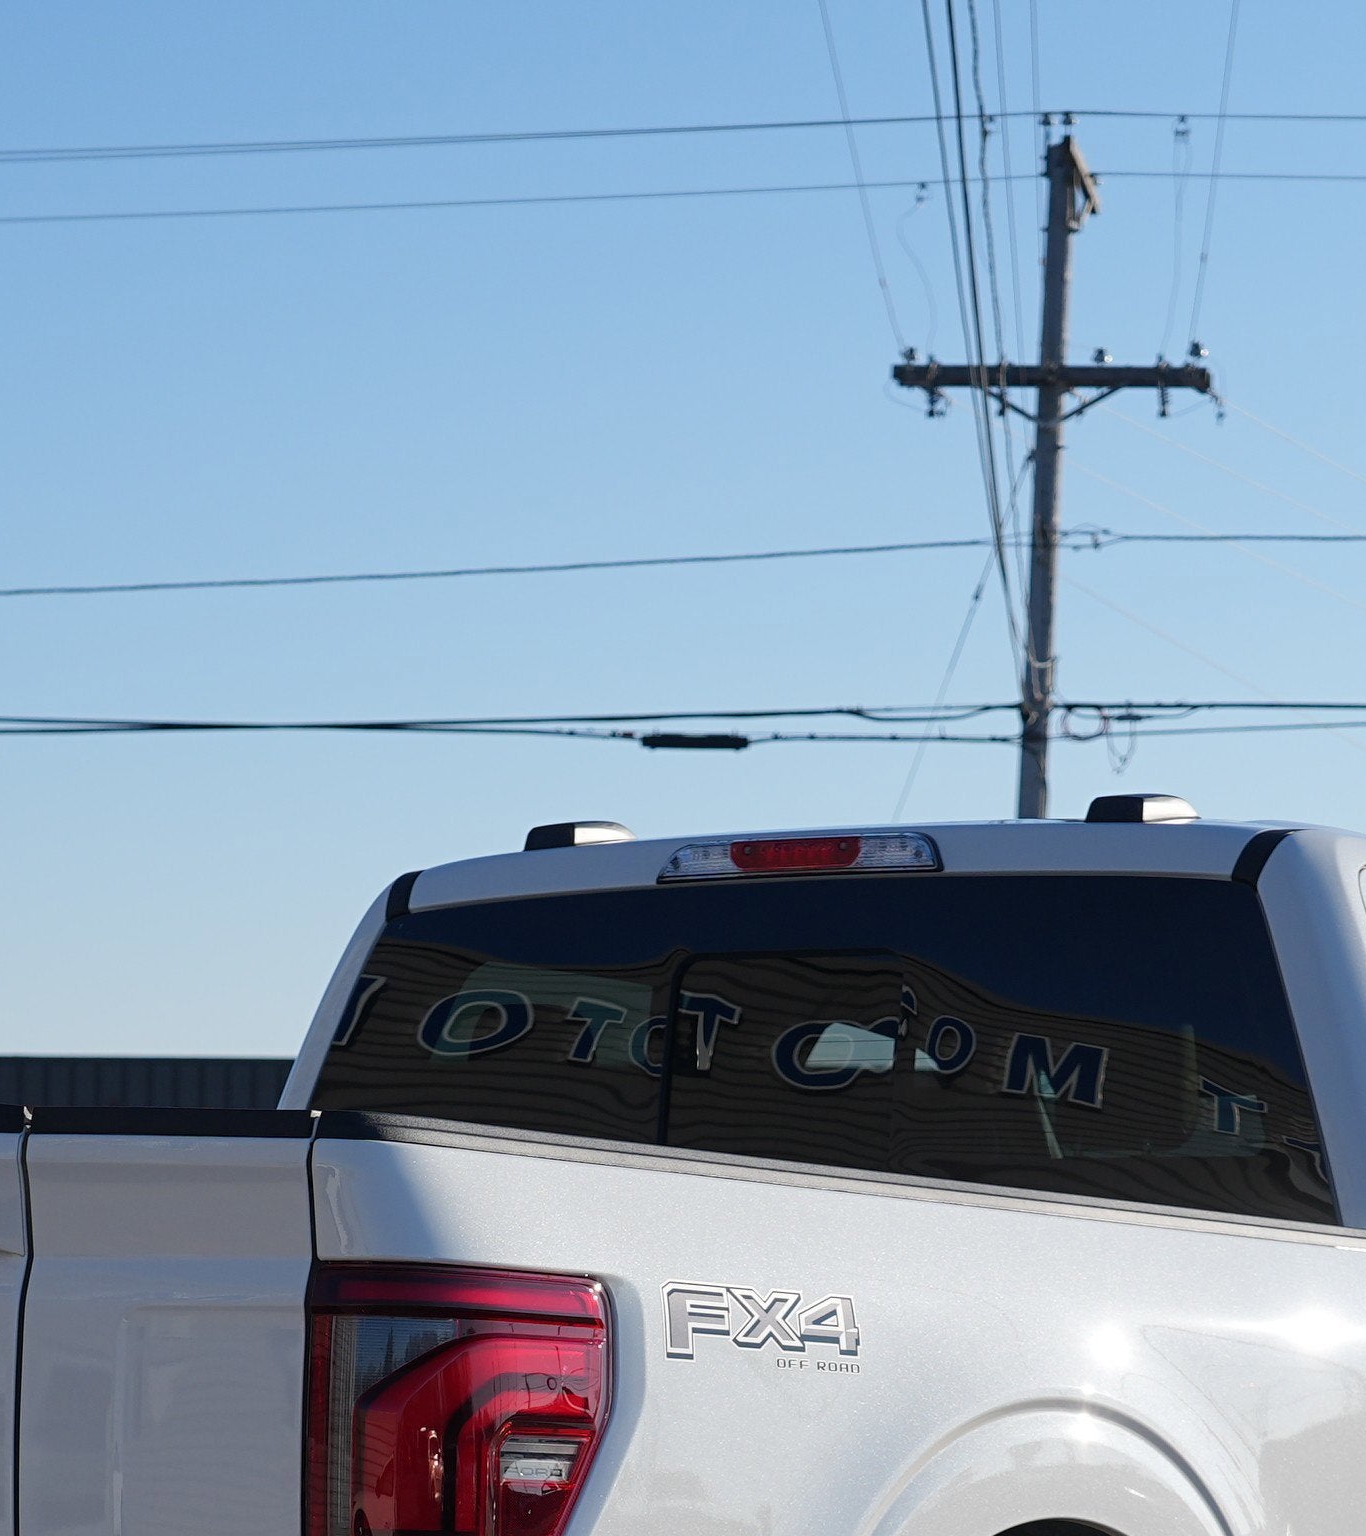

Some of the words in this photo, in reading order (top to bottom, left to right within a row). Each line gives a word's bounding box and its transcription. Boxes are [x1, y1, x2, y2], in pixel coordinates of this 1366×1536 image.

[661, 1280, 860, 1361] FX4
[776, 1358, 809, 1369] OFF
[816, 1361, 860, 1373] ROAD
